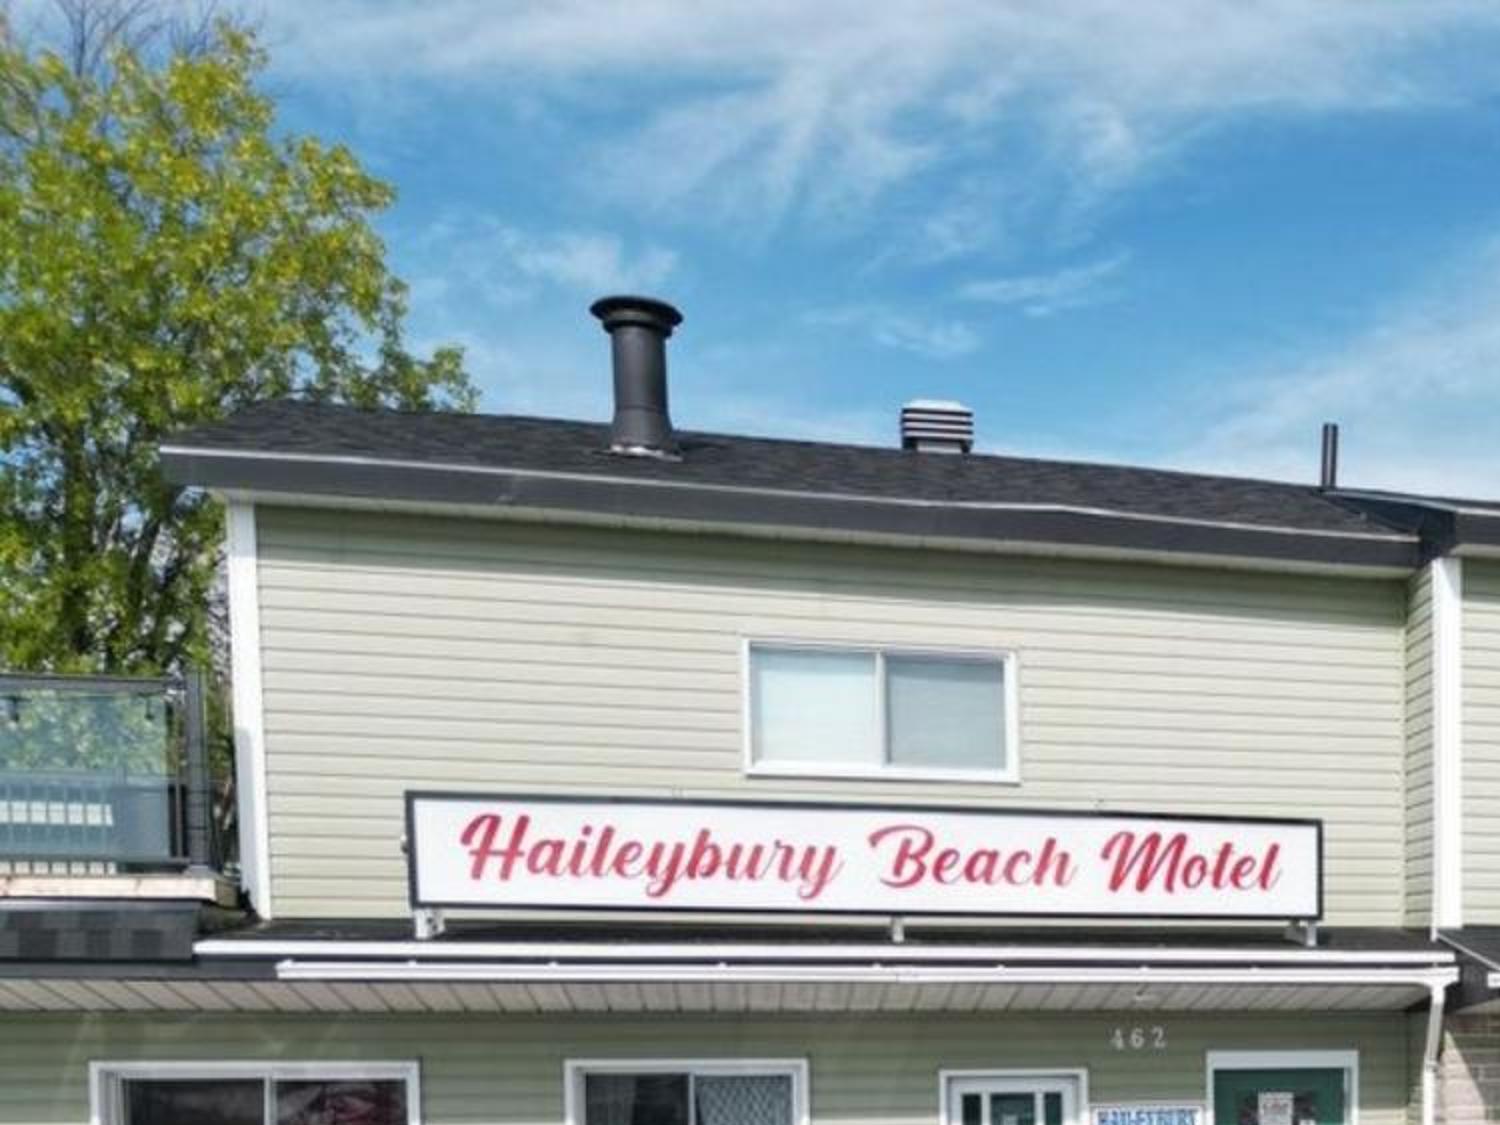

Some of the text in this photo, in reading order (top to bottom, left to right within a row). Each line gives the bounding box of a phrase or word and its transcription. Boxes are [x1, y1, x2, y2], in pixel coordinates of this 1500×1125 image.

[460, 813, 1282, 899] Haileybury Beach Motel
[1111, 1026, 1166, 1050] 462
